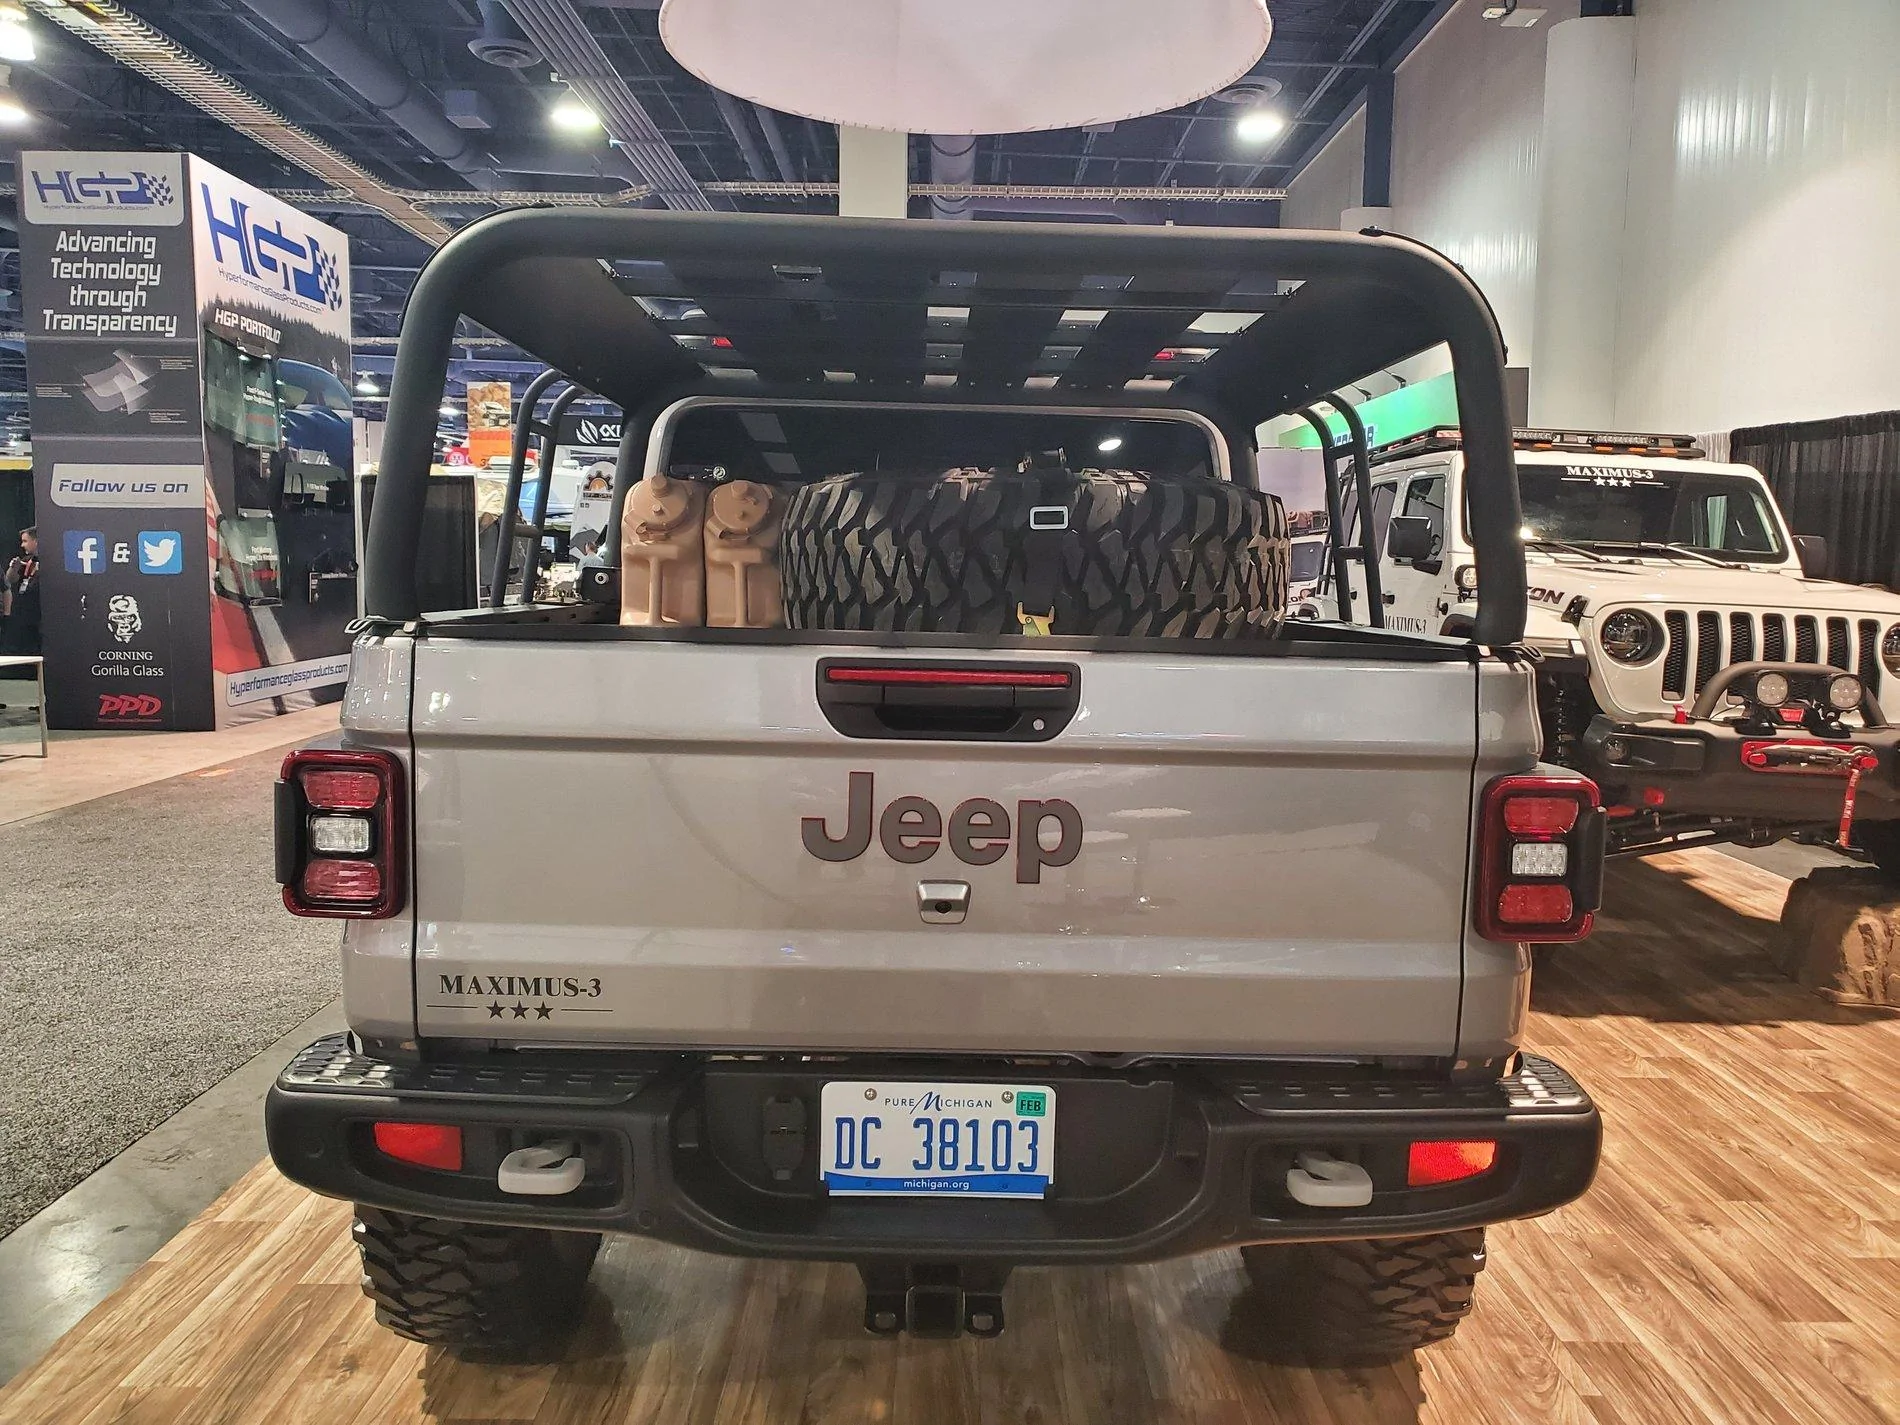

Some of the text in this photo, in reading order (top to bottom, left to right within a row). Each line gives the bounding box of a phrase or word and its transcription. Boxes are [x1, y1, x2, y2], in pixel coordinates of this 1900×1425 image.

[55, 230, 157, 259] Advancing
[51, 256, 162, 286] Technology
[69, 284, 147, 313] through
[43, 309, 177, 338] Transparency
[214, 308, 282, 344] HGP PORTFOLIO
[1565, 466, 1654, 480] MAXIMUS-3
[59, 479, 188, 493] Follow us on
[112, 542, 131, 563] &
[98, 651, 154, 661] CORNING
[91, 664, 164, 676] Gorilla Glass
[230, 663, 348, 697] Hyperformanceglassproducts.com
[99, 693, 163, 716] PPD
[801, 771, 1084, 884] Jeep
[438, 974, 602, 998] MAXIMUS-3
[884, 1090, 992, 1115] PURE MICHIGAN
[1020, 1099, 1042, 1112] FEB
[834, 1116, 1039, 1173] DC 38103
[903, 1177, 970, 1190] michigan.org
